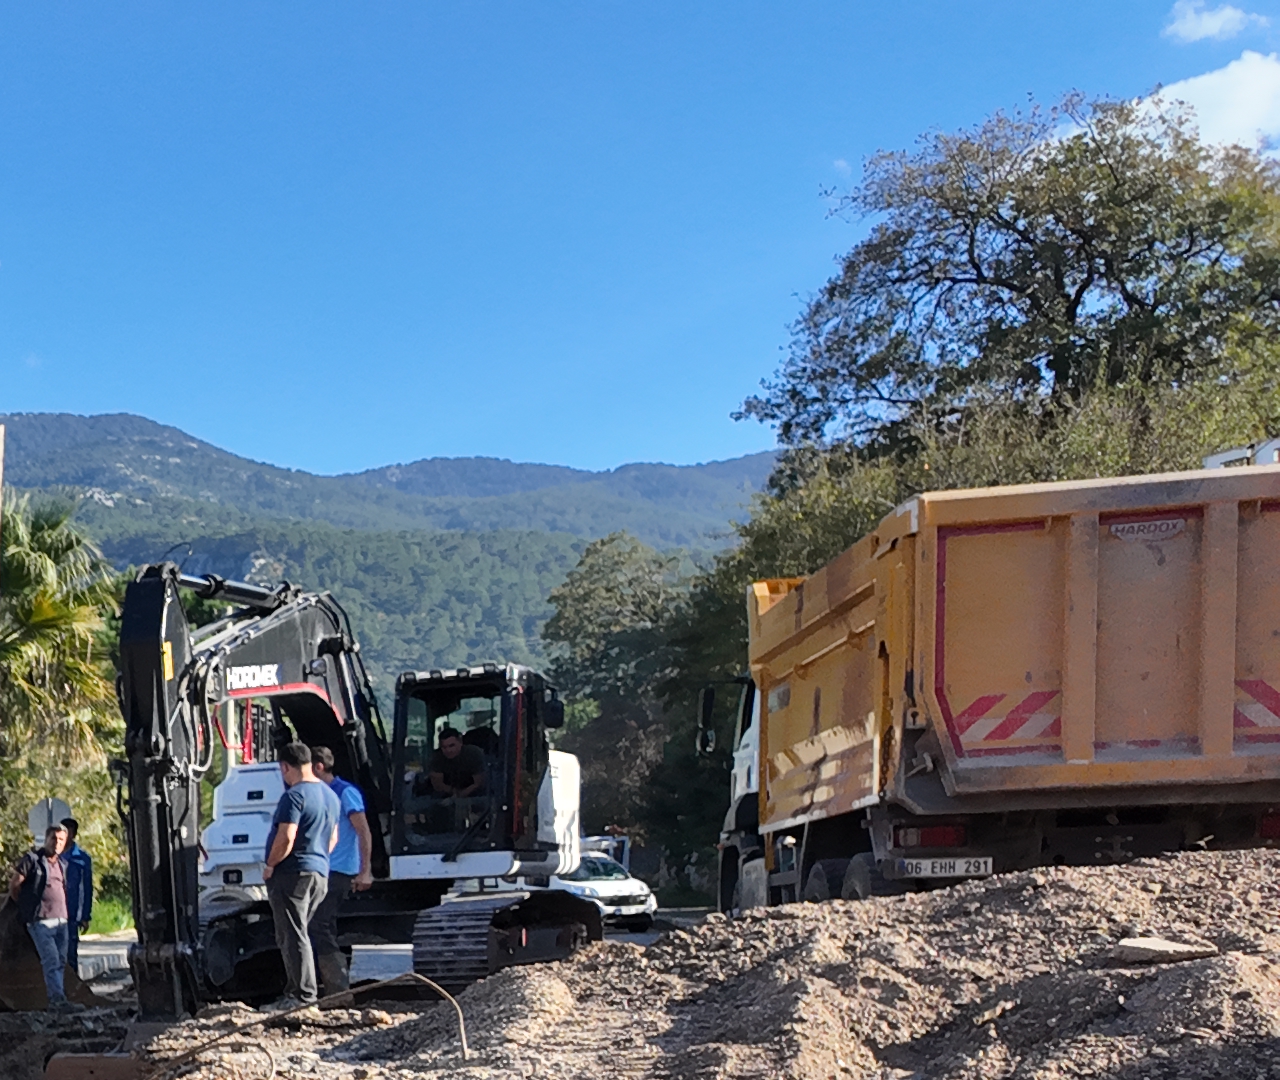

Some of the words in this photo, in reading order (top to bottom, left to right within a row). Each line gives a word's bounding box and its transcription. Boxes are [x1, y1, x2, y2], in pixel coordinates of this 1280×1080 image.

[1114, 521, 1179, 535] HARDOX
[906, 861, 922, 875] 06
[964, 860, 988, 874] 291
